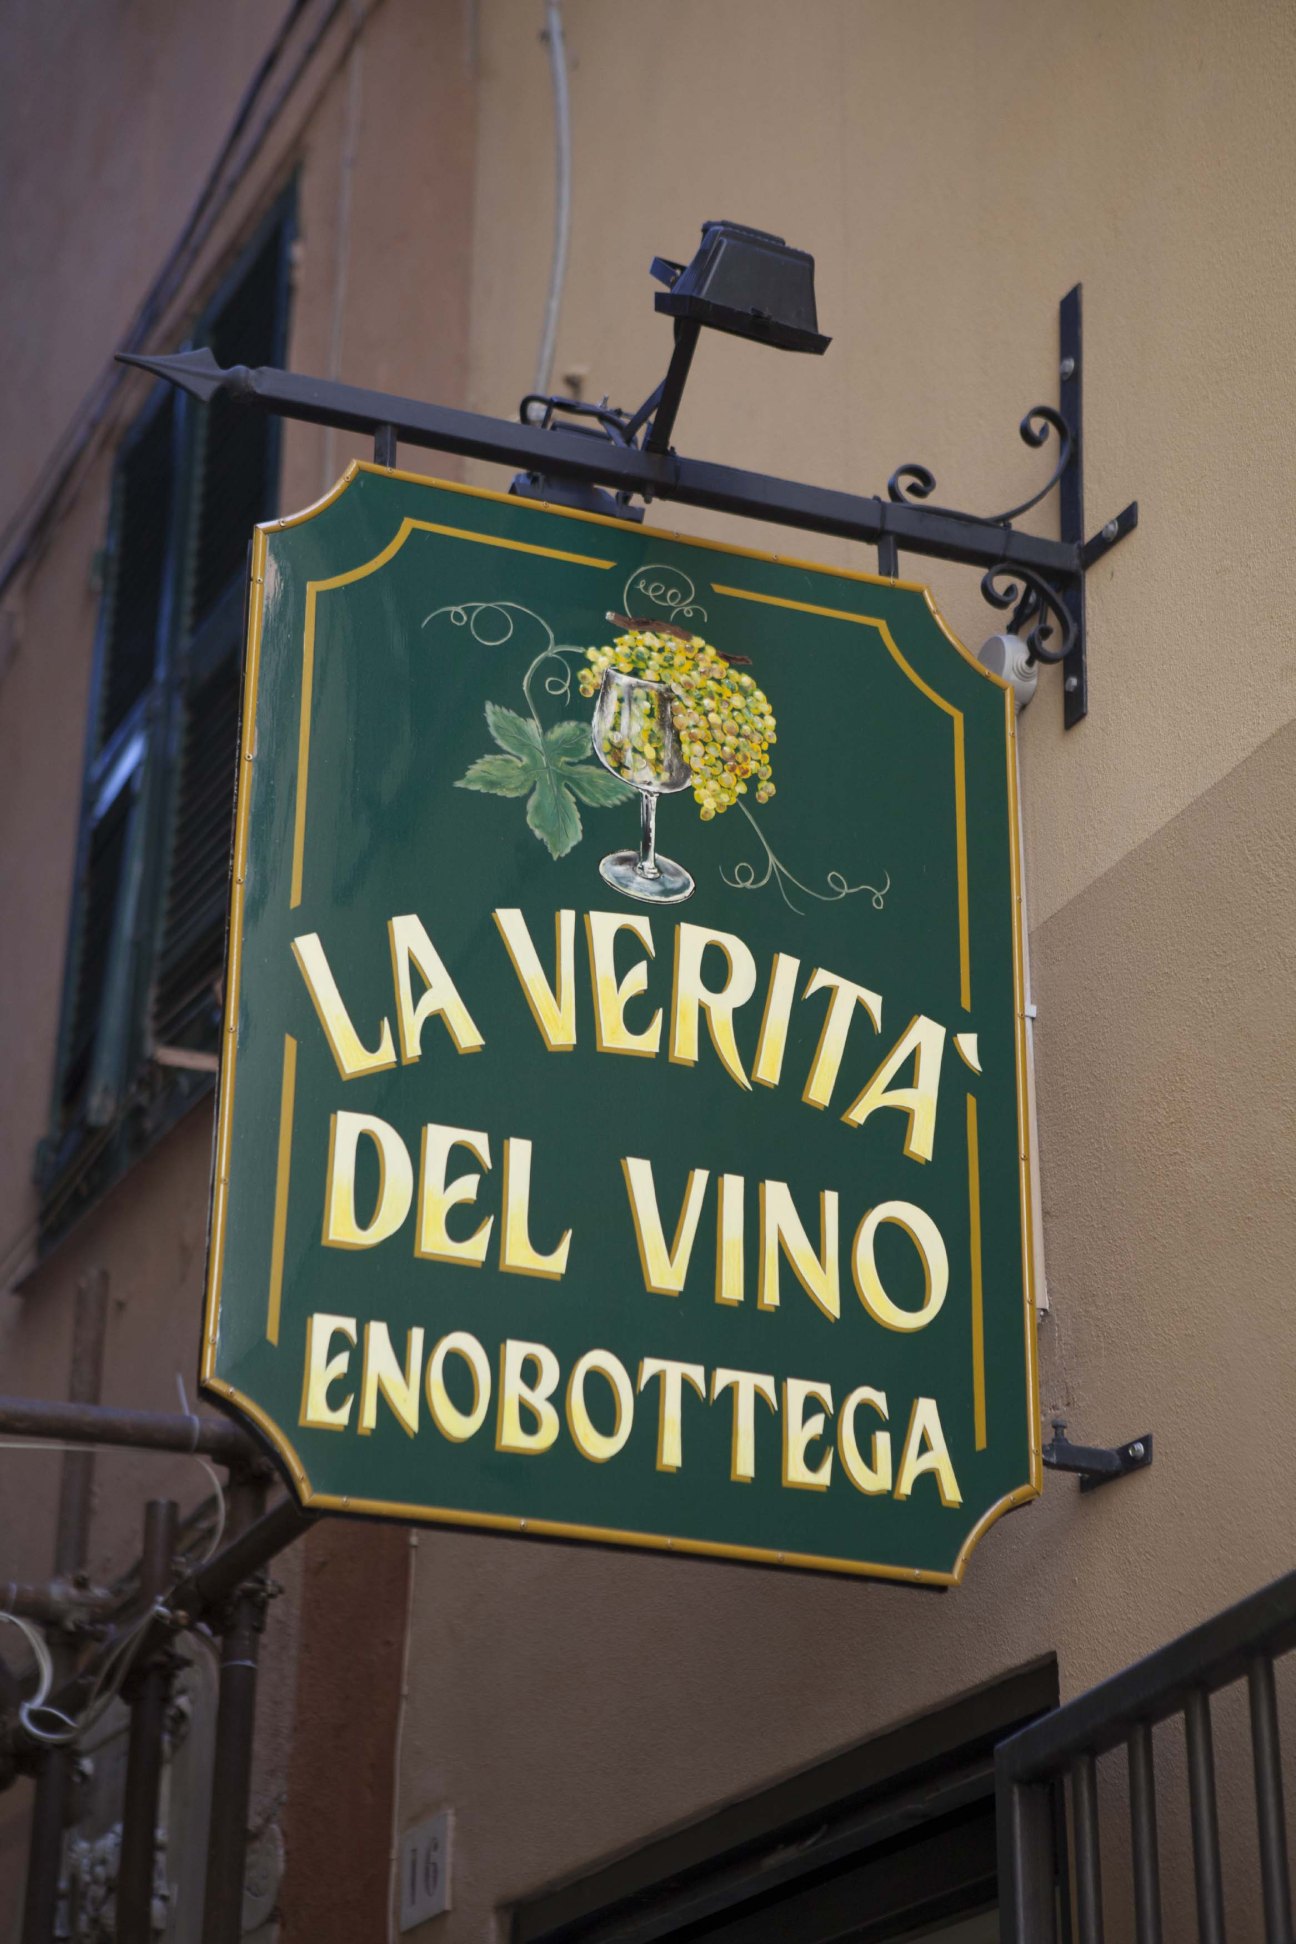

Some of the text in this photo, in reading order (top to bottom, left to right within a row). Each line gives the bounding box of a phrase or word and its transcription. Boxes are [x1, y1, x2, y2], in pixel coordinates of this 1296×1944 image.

[291, 913, 485, 1081] LA
[321, 1110, 949, 1333] DEL VINO
[298, 1313, 964, 1508] ENOBOTTEGA
[410, 1837, 438, 1906] 16
